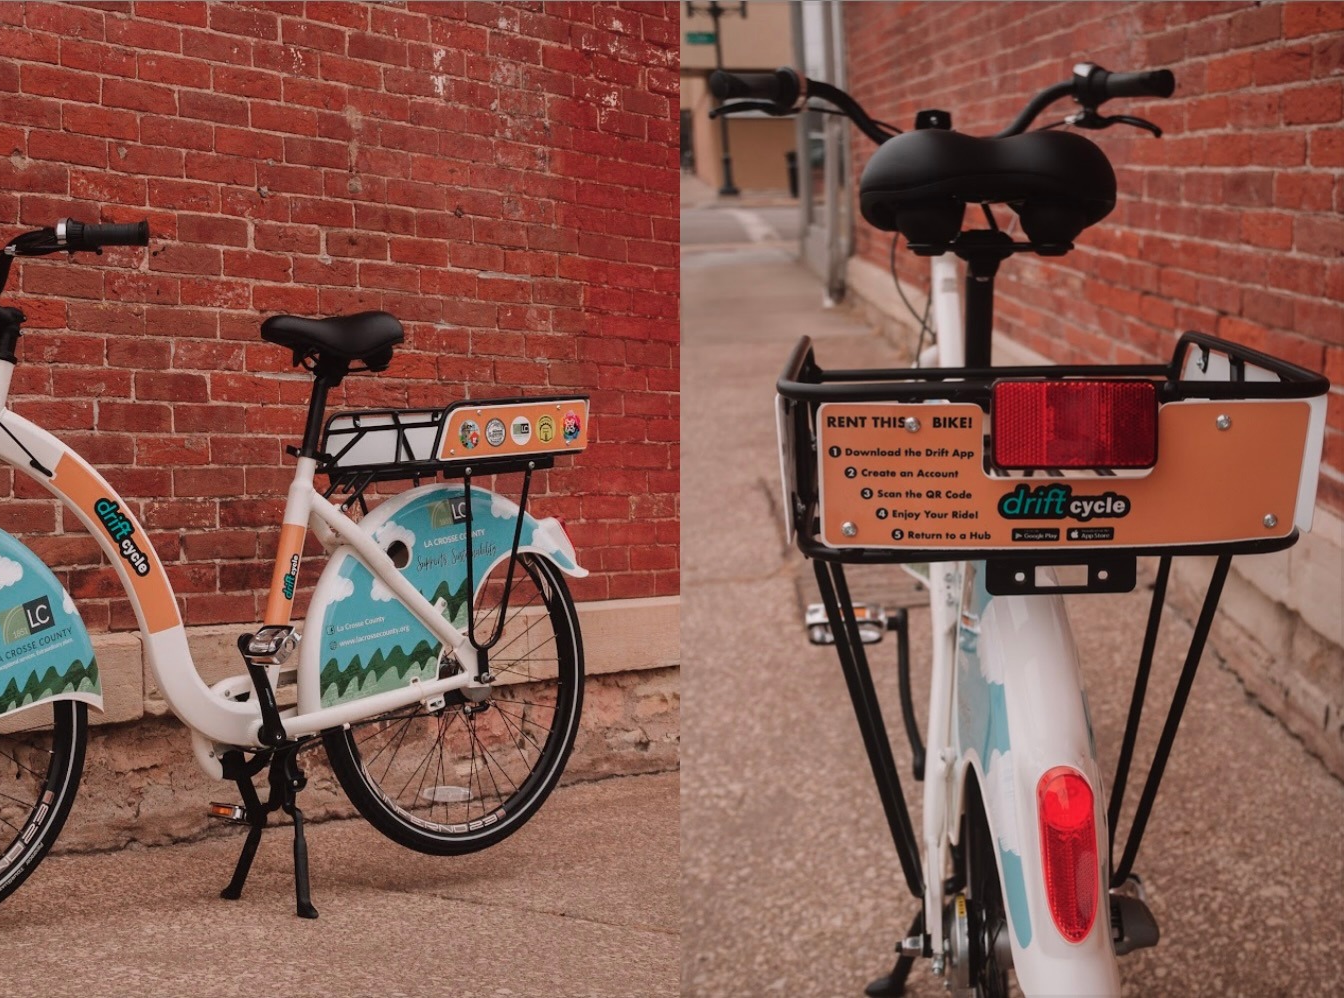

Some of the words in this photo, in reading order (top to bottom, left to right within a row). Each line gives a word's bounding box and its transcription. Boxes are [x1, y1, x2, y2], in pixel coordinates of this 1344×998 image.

[827, 416, 866, 428] RENT
[872, 417, 906, 428] THIS
[932, 417, 972, 428] BIKE!
[845, 448, 901, 457] Download
[905, 448, 921, 457] the
[926, 449, 949, 457] Drift
[952, 449, 974, 459] App
[861, 469, 896, 478] Create
[917, 470, 958, 478] Account
[877, 490, 902, 498] Scan
[905, 490, 922, 498] the
[926, 490, 941, 499] QR
[946, 490, 972, 499] Code
[1004, 488, 1067, 514] drift
[1070, 497, 1125, 517] cycle
[452, 502, 466, 519] LC
[892, 510, 921, 520] Enjoy
[924, 510, 948, 519] Your
[952, 511, 978, 519] Ride!
[97, 500, 132, 540] drift
[121, 539, 148, 574] cycle
[434, 534, 458, 546] CROSSE
[459, 529, 485, 540] CONTY
[908, 532, 942, 540] Return
[283, 574, 295, 599] drift
[290, 555, 298, 576] cycle
[26, 604, 50, 628] LC
[345, 621, 364, 630] Crosse
[364, 616, 384, 625] County
[13, 627, 28, 638] 1851
[5, 641, 37, 660] CROSSE
[39, 627, 72, 646] COUNTY
